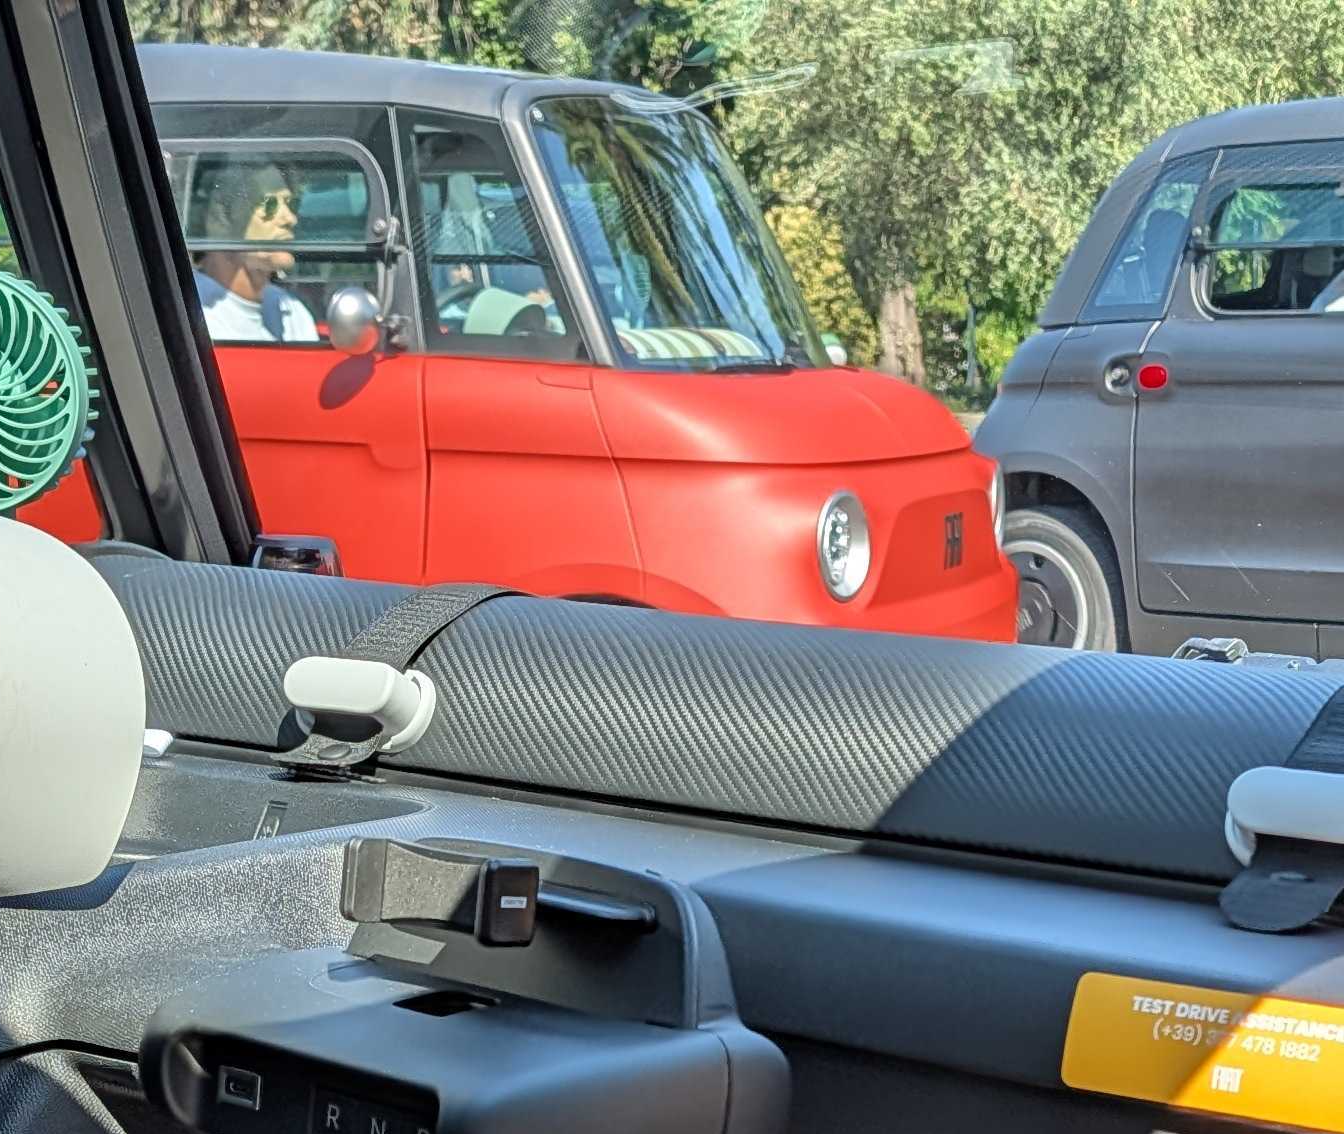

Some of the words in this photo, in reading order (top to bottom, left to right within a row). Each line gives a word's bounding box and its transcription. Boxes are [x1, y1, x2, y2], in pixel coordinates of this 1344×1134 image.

[1132, 996, 1174, 1015] TEST
[1176, 1002, 1230, 1024] DRIVE
[1153, 1017, 1202, 1046] (+39)
[1240, 1035, 1275, 1055] 478
[1280, 1040, 1321, 1063] 1882
[326, 1104, 340, 1130] R
